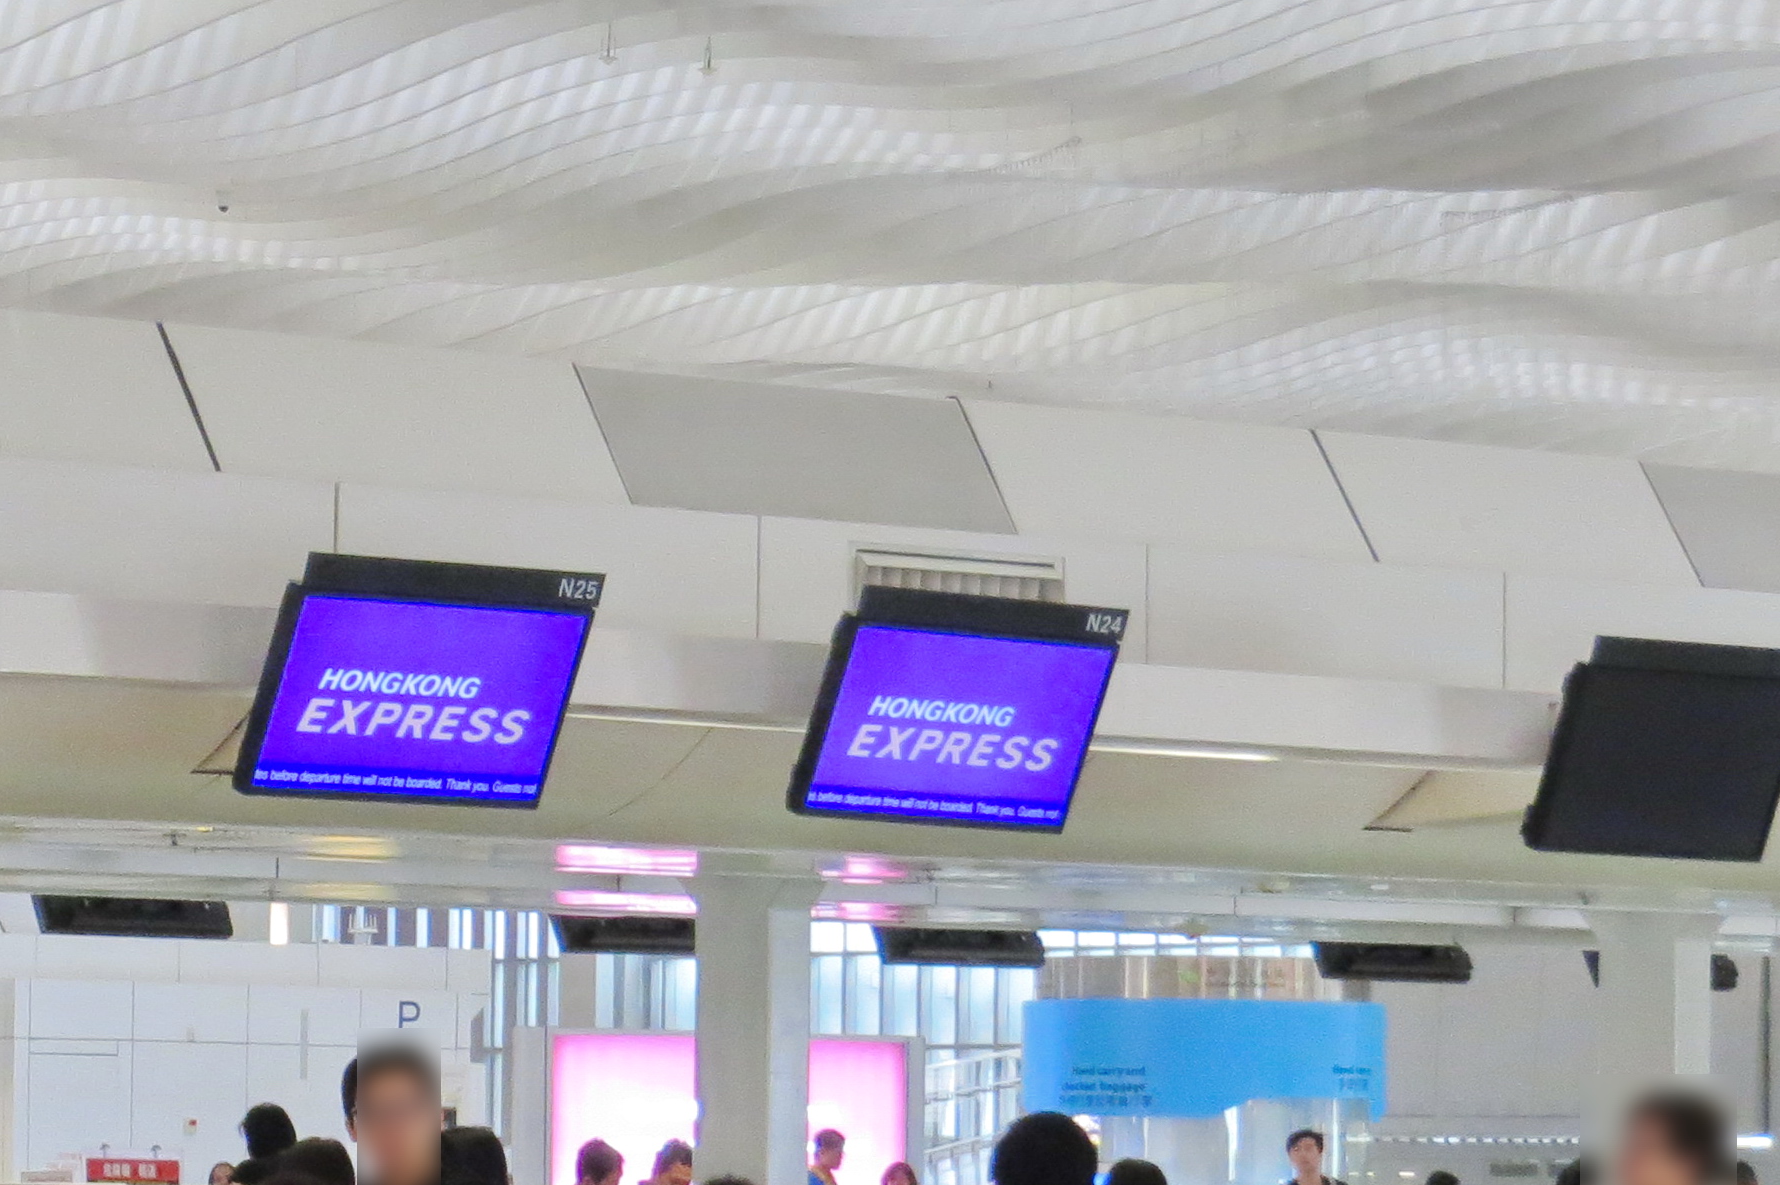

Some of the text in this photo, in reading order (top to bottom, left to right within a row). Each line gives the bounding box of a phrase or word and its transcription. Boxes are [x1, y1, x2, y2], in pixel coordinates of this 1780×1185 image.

[559, 578, 599, 599] N25
[1086, 613, 1121, 635] N24
[318, 667, 481, 698] HONGKONG
[296, 698, 531, 744] EXPRESS
[867, 695, 1016, 727] HONGKONG
[847, 724, 1059, 771] EXPRESS
[446, 778, 472, 791] Thank
[398, 1000, 421, 1028] P
